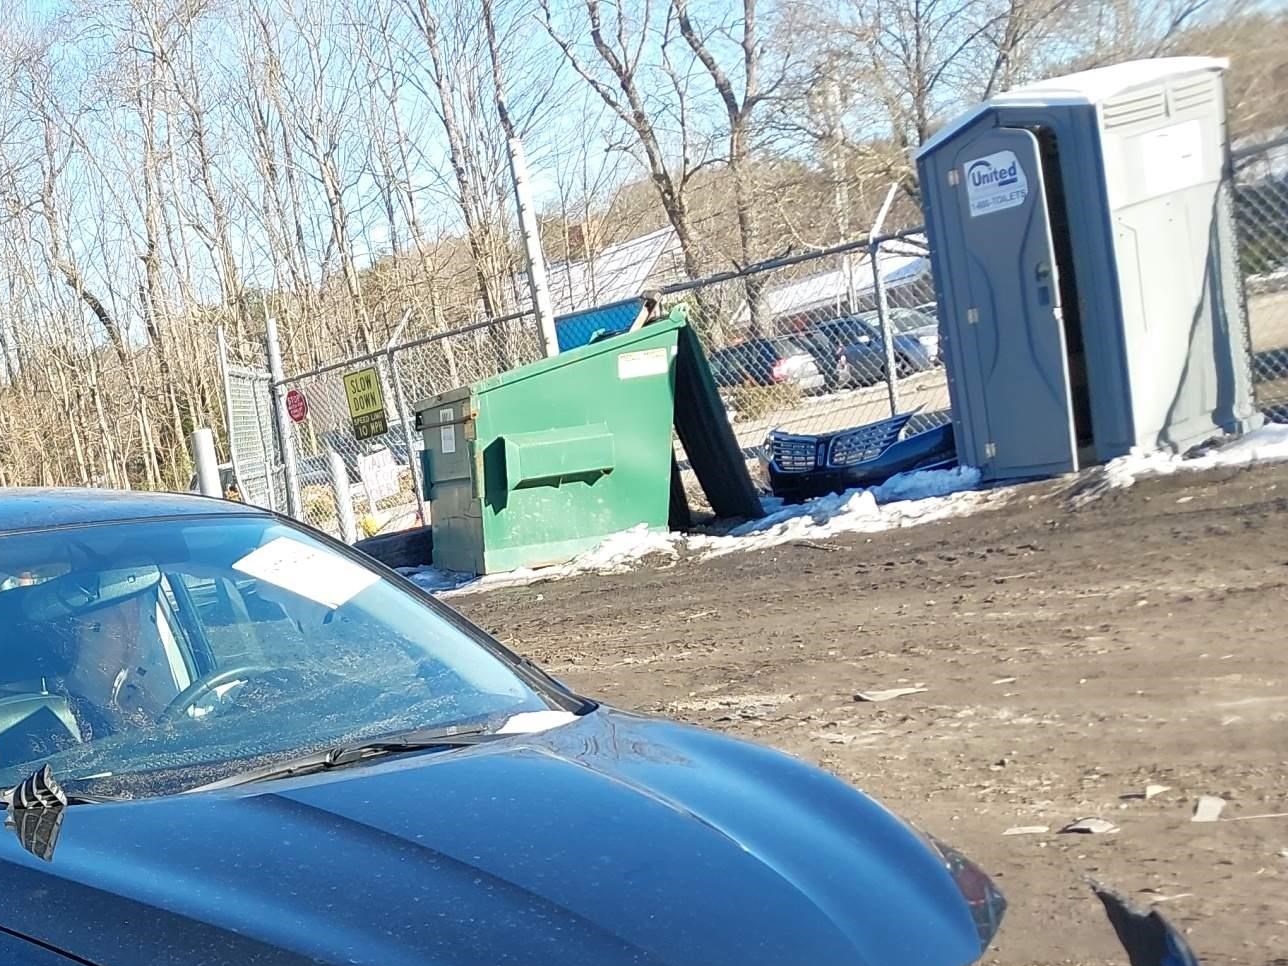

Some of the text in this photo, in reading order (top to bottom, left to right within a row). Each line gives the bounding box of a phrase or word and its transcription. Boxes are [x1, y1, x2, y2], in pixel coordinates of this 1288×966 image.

[973, 161, 1016, 187] United
[350, 375, 373, 394] SLOW
[353, 392, 377, 411] DOWN
[353, 415, 370, 425] SPEED
[359, 420, 384, 437] 10 MPH
